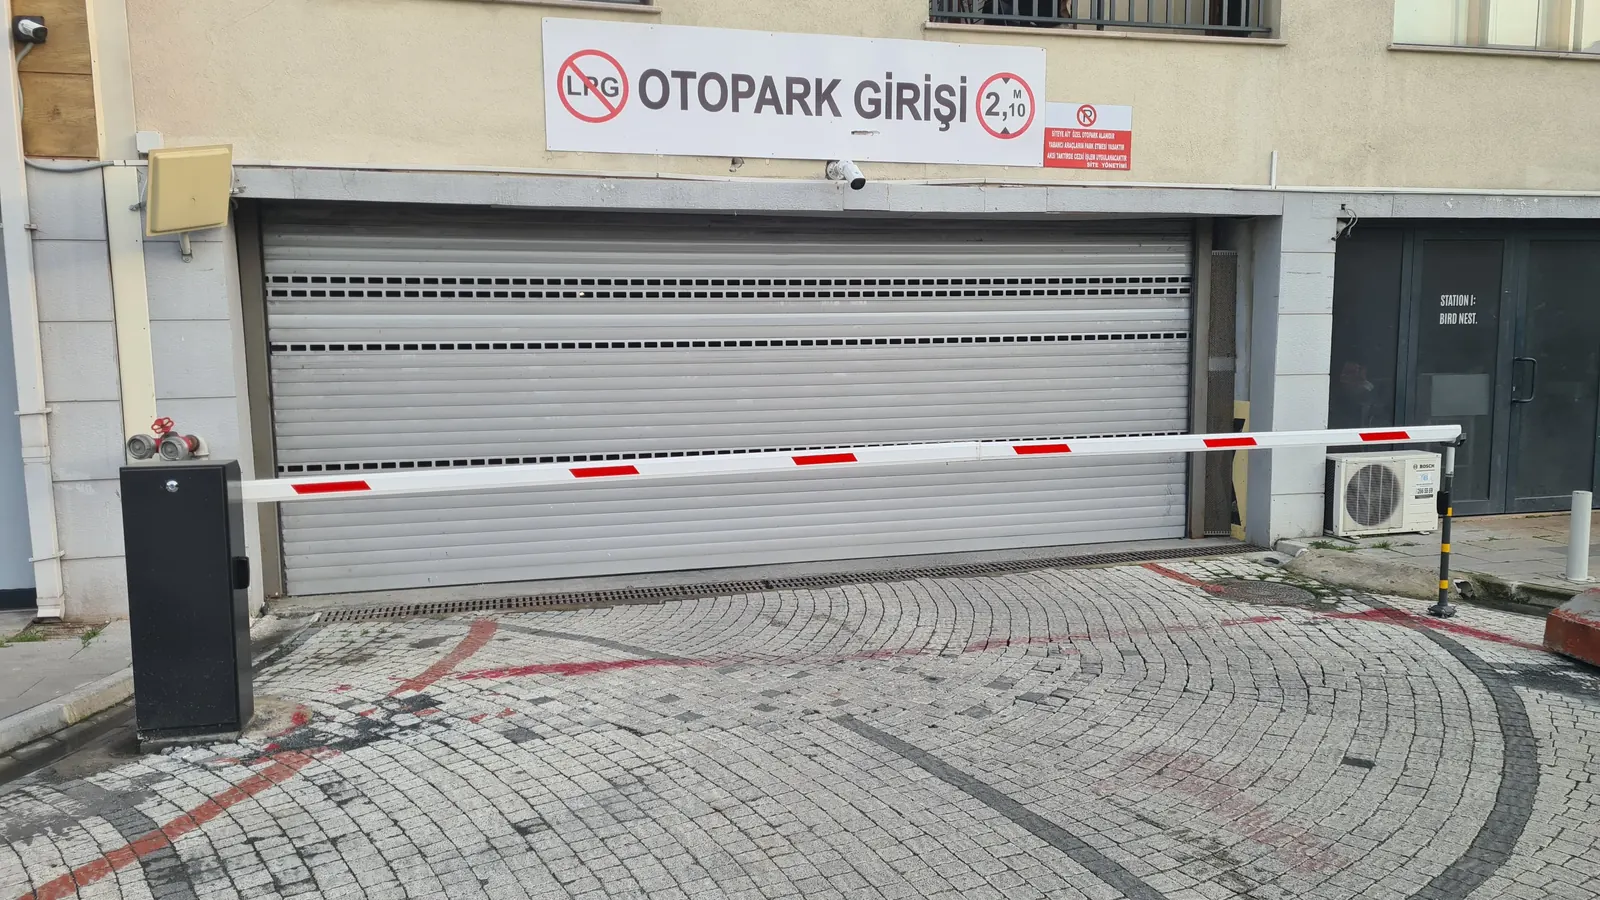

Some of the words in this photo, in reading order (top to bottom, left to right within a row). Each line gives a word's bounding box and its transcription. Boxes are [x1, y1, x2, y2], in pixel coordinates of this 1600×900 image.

[566, 75, 620, 98] LPG
[638, 68, 842, 117] OTOPARK
[854, 71, 967, 131] GİRİŞİ
[1082, 131, 1098, 139] OTOPARK
[1440, 294, 1469, 306] STATION
[1439, 312, 1457, 325] BIRD
[1458, 312, 1478, 325] NEST.
